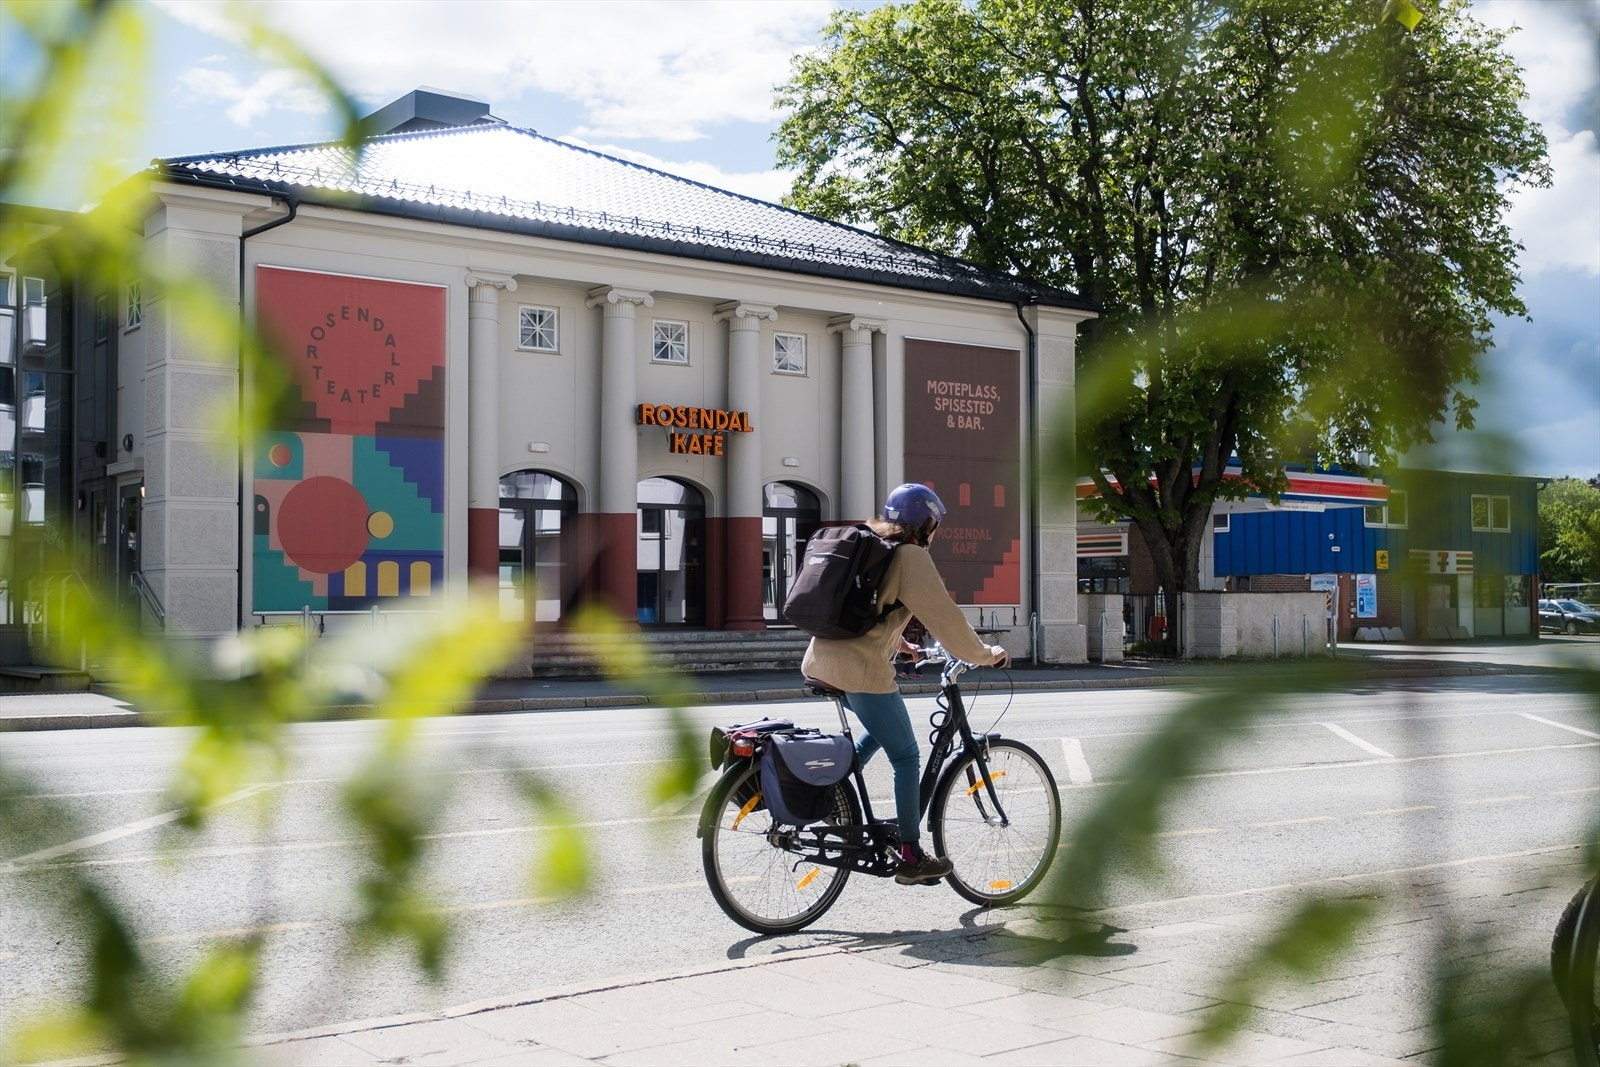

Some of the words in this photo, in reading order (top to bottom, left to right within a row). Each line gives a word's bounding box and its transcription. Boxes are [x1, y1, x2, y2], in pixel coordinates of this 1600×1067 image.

[306, 305, 400, 366] ROSENDAL
[312, 365, 396, 403] TEATER
[927, 379, 1001, 402] MØTEPLASS,
[934, 396, 994, 415] SPISESTED
[639, 403, 755, 433] ROSENDAL
[946, 414, 955, 429] &
[957, 415, 985, 431] BAR.
[671, 431, 725, 457] KAFÉ
[936, 527, 992, 541] ROSENDAL
